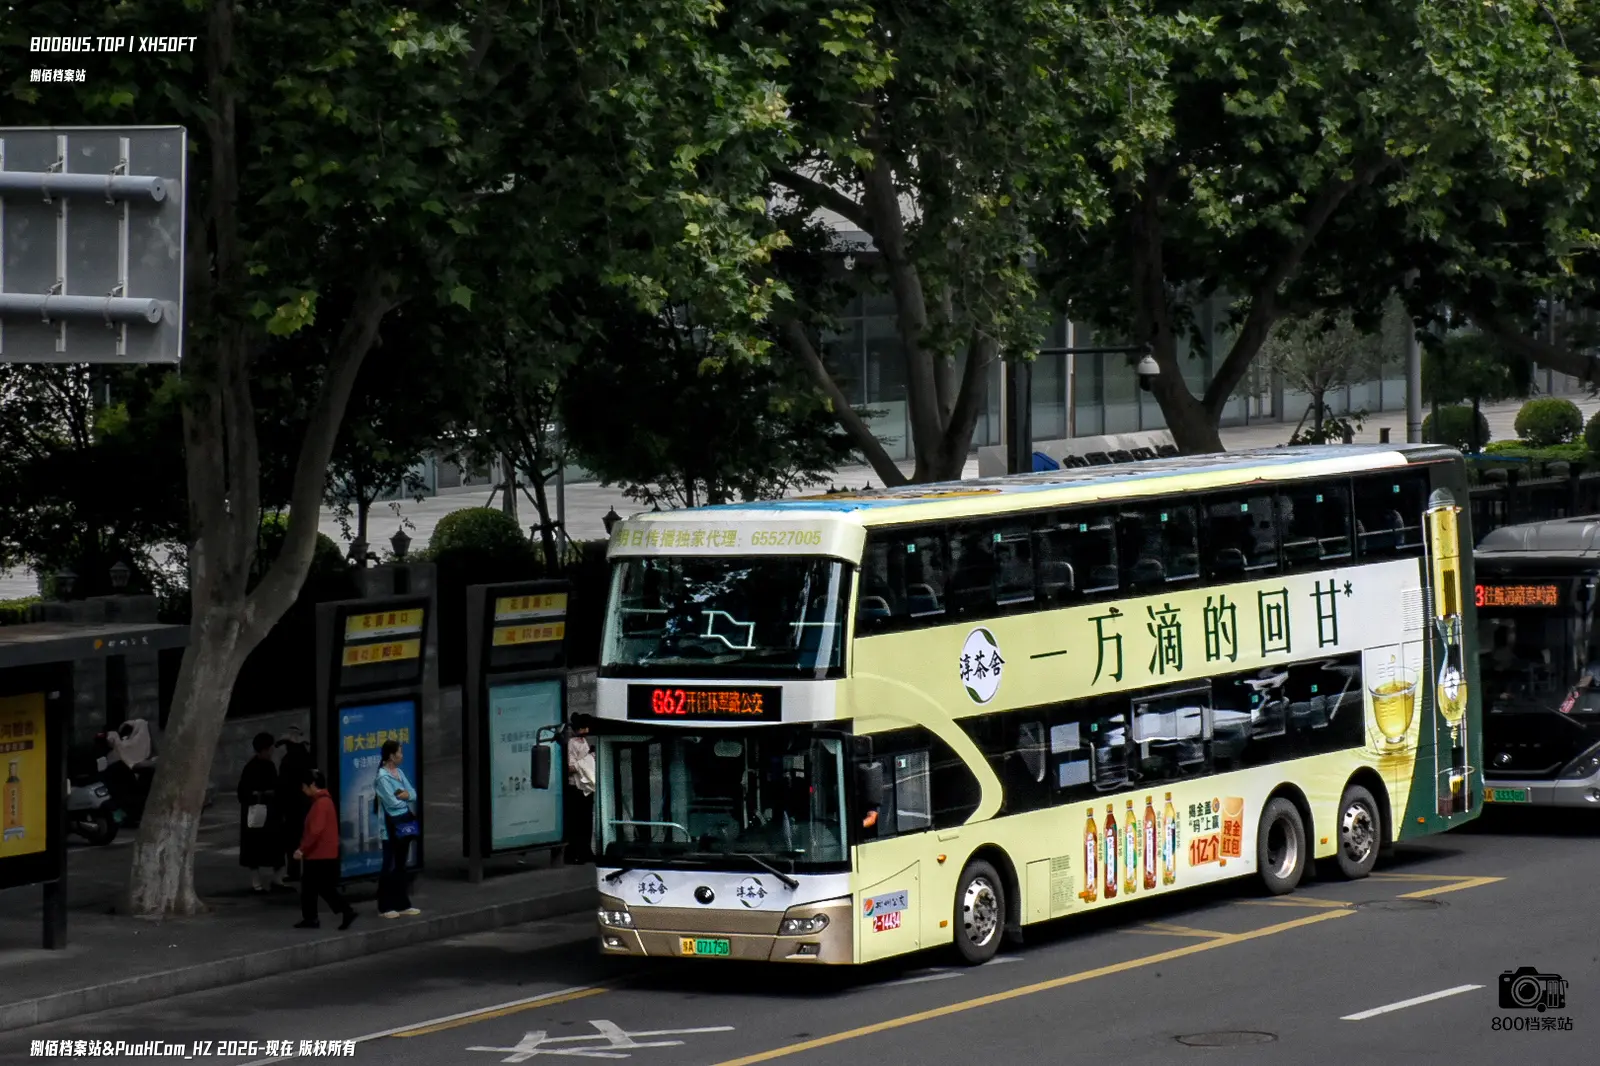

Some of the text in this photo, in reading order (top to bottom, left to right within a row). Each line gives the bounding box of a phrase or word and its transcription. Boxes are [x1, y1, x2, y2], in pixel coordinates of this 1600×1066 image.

[751, 530, 822, 546] 65527005
[959, 649, 1006, 682] 淳茶舍
[1224, 820, 1241, 837] 现金
[1222, 838, 1240, 855] 红包
